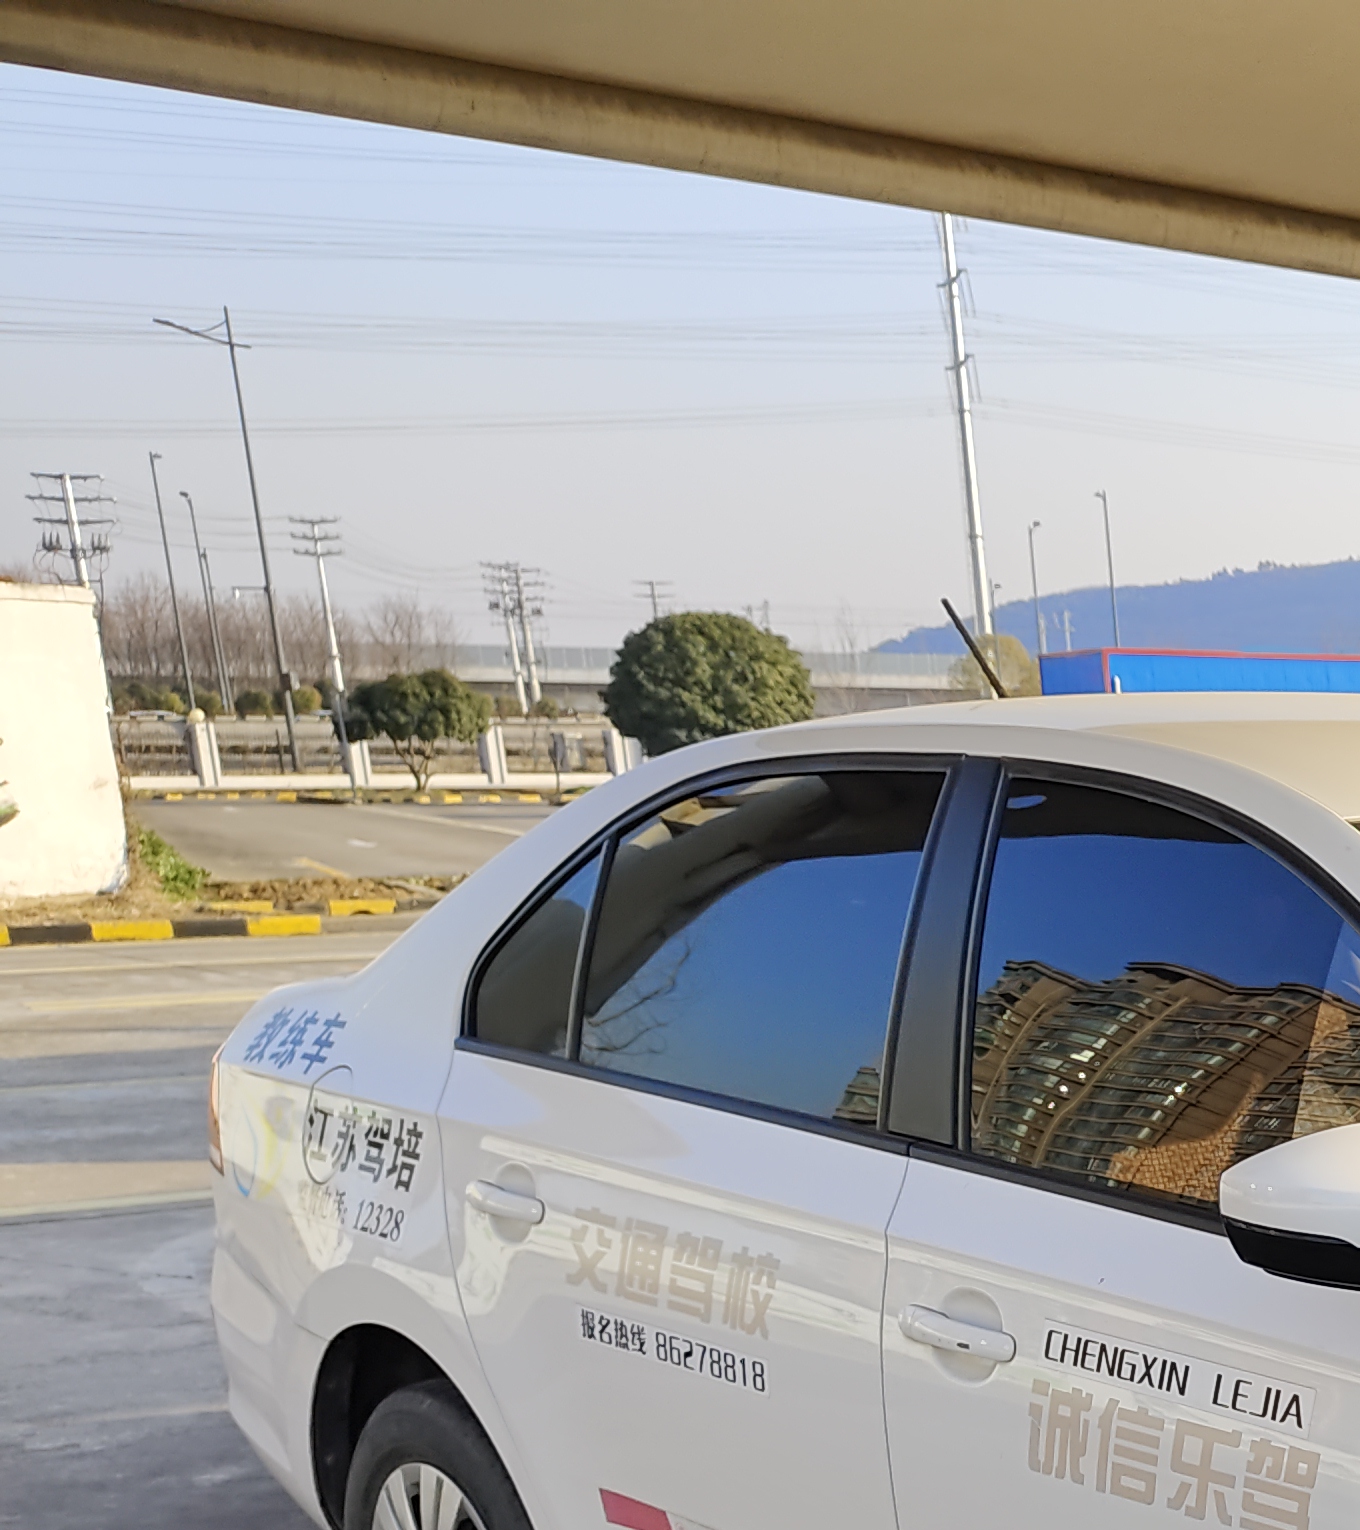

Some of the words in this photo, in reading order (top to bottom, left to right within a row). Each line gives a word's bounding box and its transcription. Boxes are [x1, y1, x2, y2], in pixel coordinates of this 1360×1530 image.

[244, 1006, 347, 1075] 教练车
[308, 1099, 423, 1193] 江苏驾培
[353, 1199, 405, 1242] 12328
[566, 1207, 781, 1340] 交通驾校
[581, 1309, 646, 1355] 报名热线
[655, 1332, 766, 1392] 86278818
[1044, 1329, 1190, 1396] CHENGXIN
[1210, 1372, 1305, 1428] LEJIA
